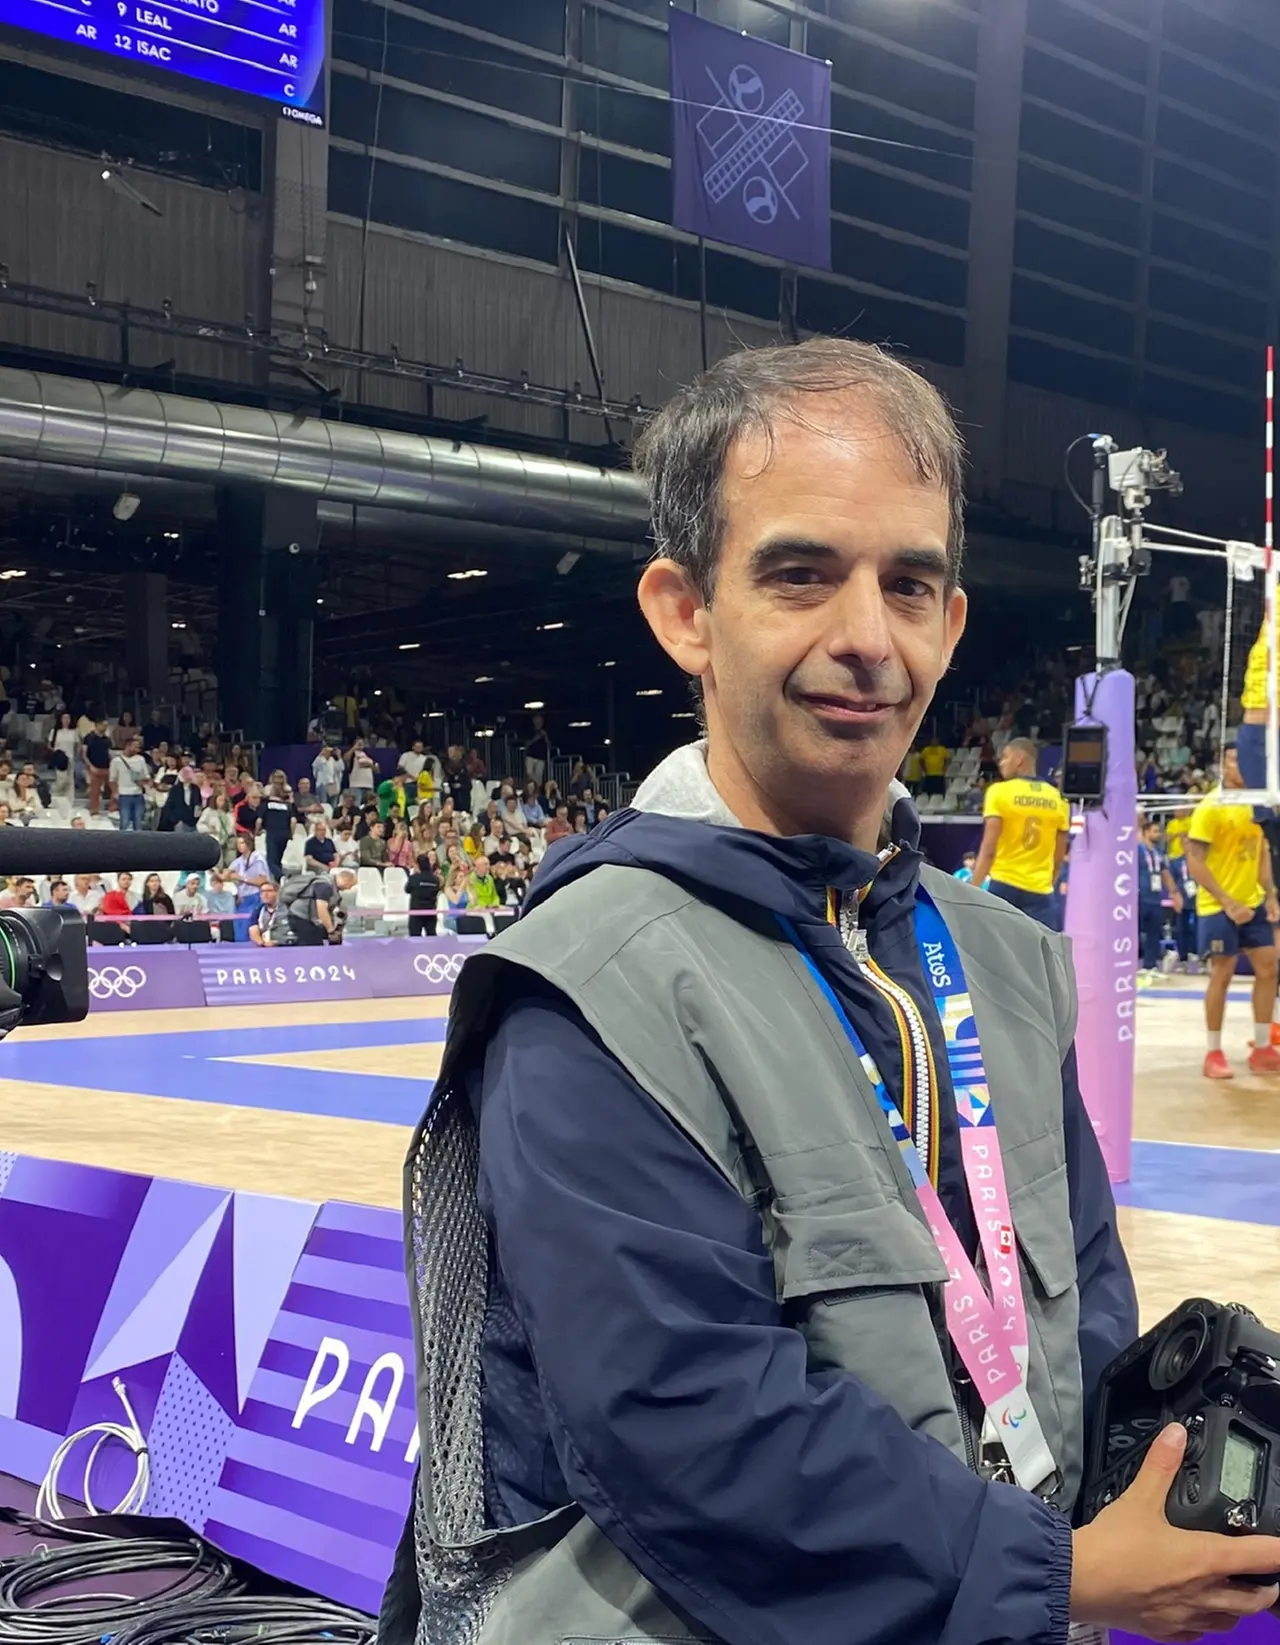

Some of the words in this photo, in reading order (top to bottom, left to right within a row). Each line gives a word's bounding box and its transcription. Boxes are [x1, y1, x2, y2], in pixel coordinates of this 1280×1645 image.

[117, 2, 127, 17] 9
[135, 7, 173, 31] LEAL
[278, 23, 298, 38] AR
[75, 23, 98, 40] AR
[114, 33, 132, 50] 12
[136, 39, 172, 61] ISAC
[279, 52, 299, 69] AR
[283, 83, 296, 97] C
[291, 107, 323, 125] OMEGA
[1021, 815, 1042, 851] 6
[1113, 825, 1134, 921] 2024
[216, 967, 288, 985] PARIS
[295, 966, 356, 983] 2024
[922, 940, 952, 988] Atos
[1114, 936, 1135, 1042] PARIS
[970, 1143, 1003, 1233] PARIS
[953, 1294, 1007, 1385] PARIS
